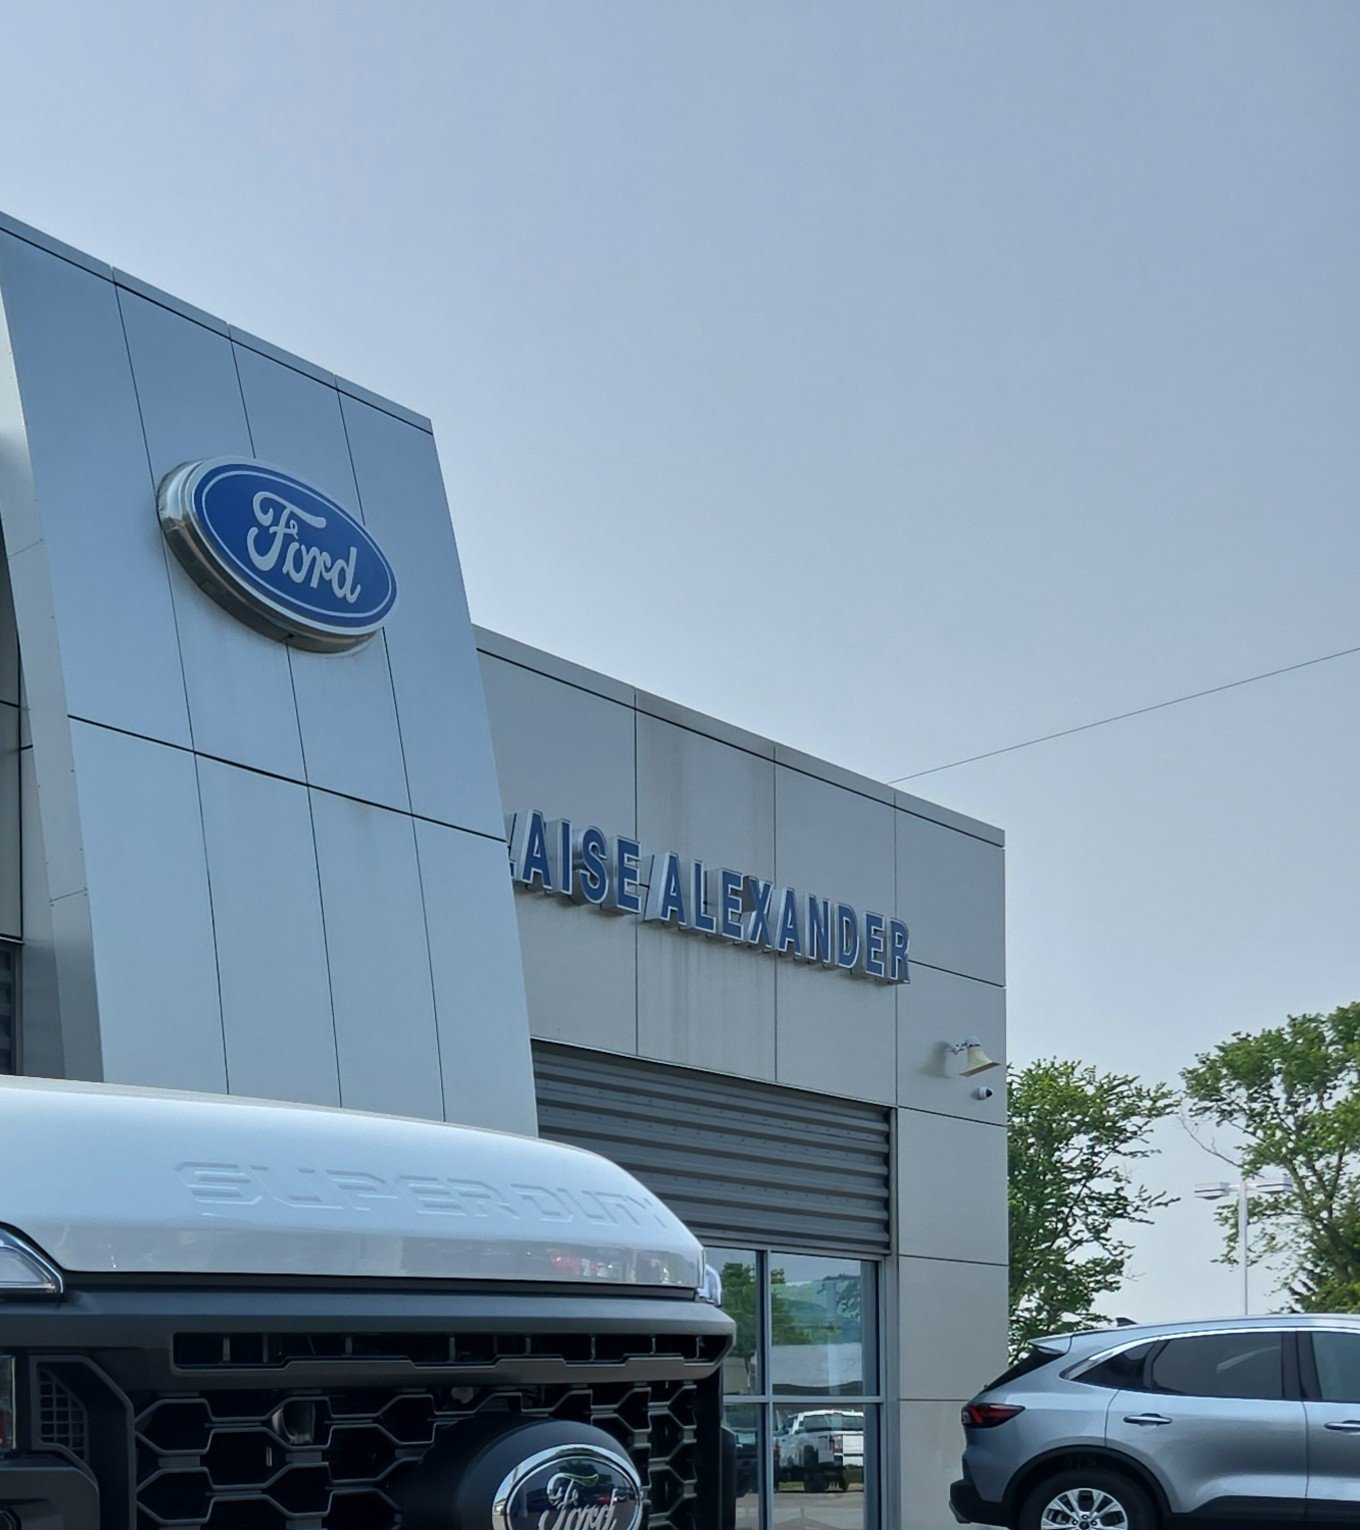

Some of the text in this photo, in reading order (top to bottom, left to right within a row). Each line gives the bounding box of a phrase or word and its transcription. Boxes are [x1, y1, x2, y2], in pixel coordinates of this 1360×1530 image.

[246, 491, 362, 604] Ford
[509, 808, 911, 985] AISE ALEXANDER
[174, 1161, 670, 1231] SUPER DUTY
